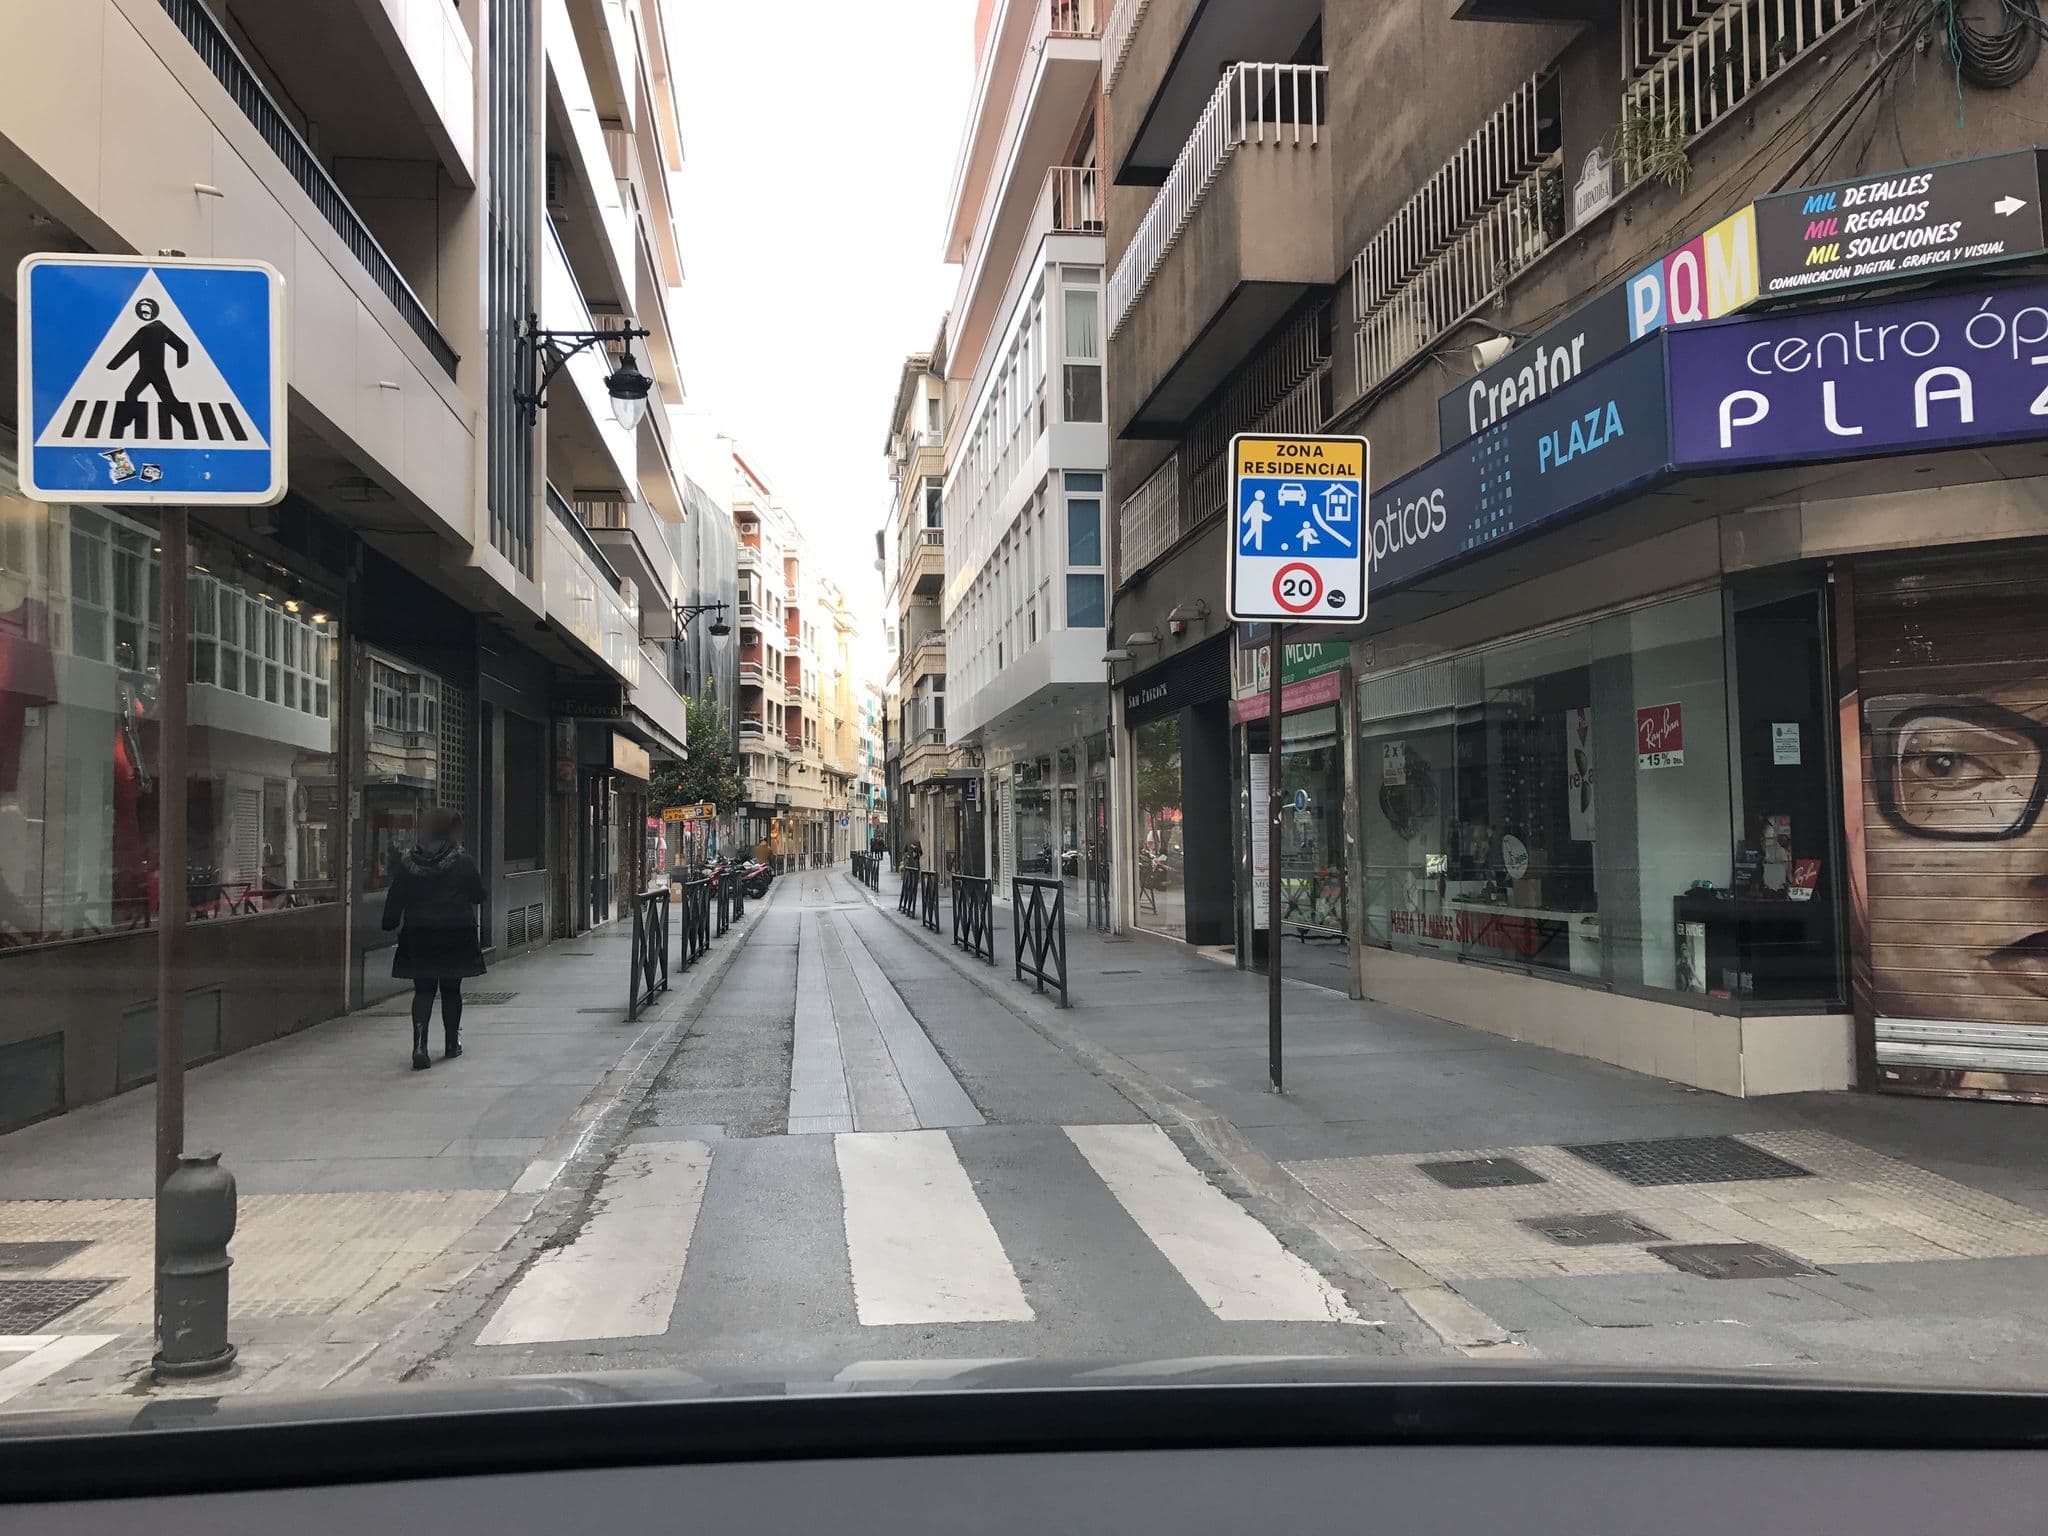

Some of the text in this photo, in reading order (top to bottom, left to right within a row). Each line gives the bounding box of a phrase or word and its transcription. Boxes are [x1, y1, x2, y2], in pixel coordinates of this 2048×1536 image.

[1802, 173, 1933, 215] MIL DETALLES
[1804, 200, 1930, 241] MIL REGALOS
[1769, 264, 1851, 291] COMUNICACIÓN
[1853, 258, 1897, 277] DIGITAL
[1964, 240, 2005, 258] VISUAL
[1805, 221, 1962, 266] MIL SOLUCIONES
[1633, 215, 1752, 337] PQM
[1747, 320, 1940, 375] centro
[1468, 332, 1586, 436] Creator
[1276, 444, 1324, 457] ZONA
[1538, 400, 1625, 474] PLAZA
[1244, 461, 1356, 476] RESIDENCIAL
[1283, 579, 1313, 597] 20
